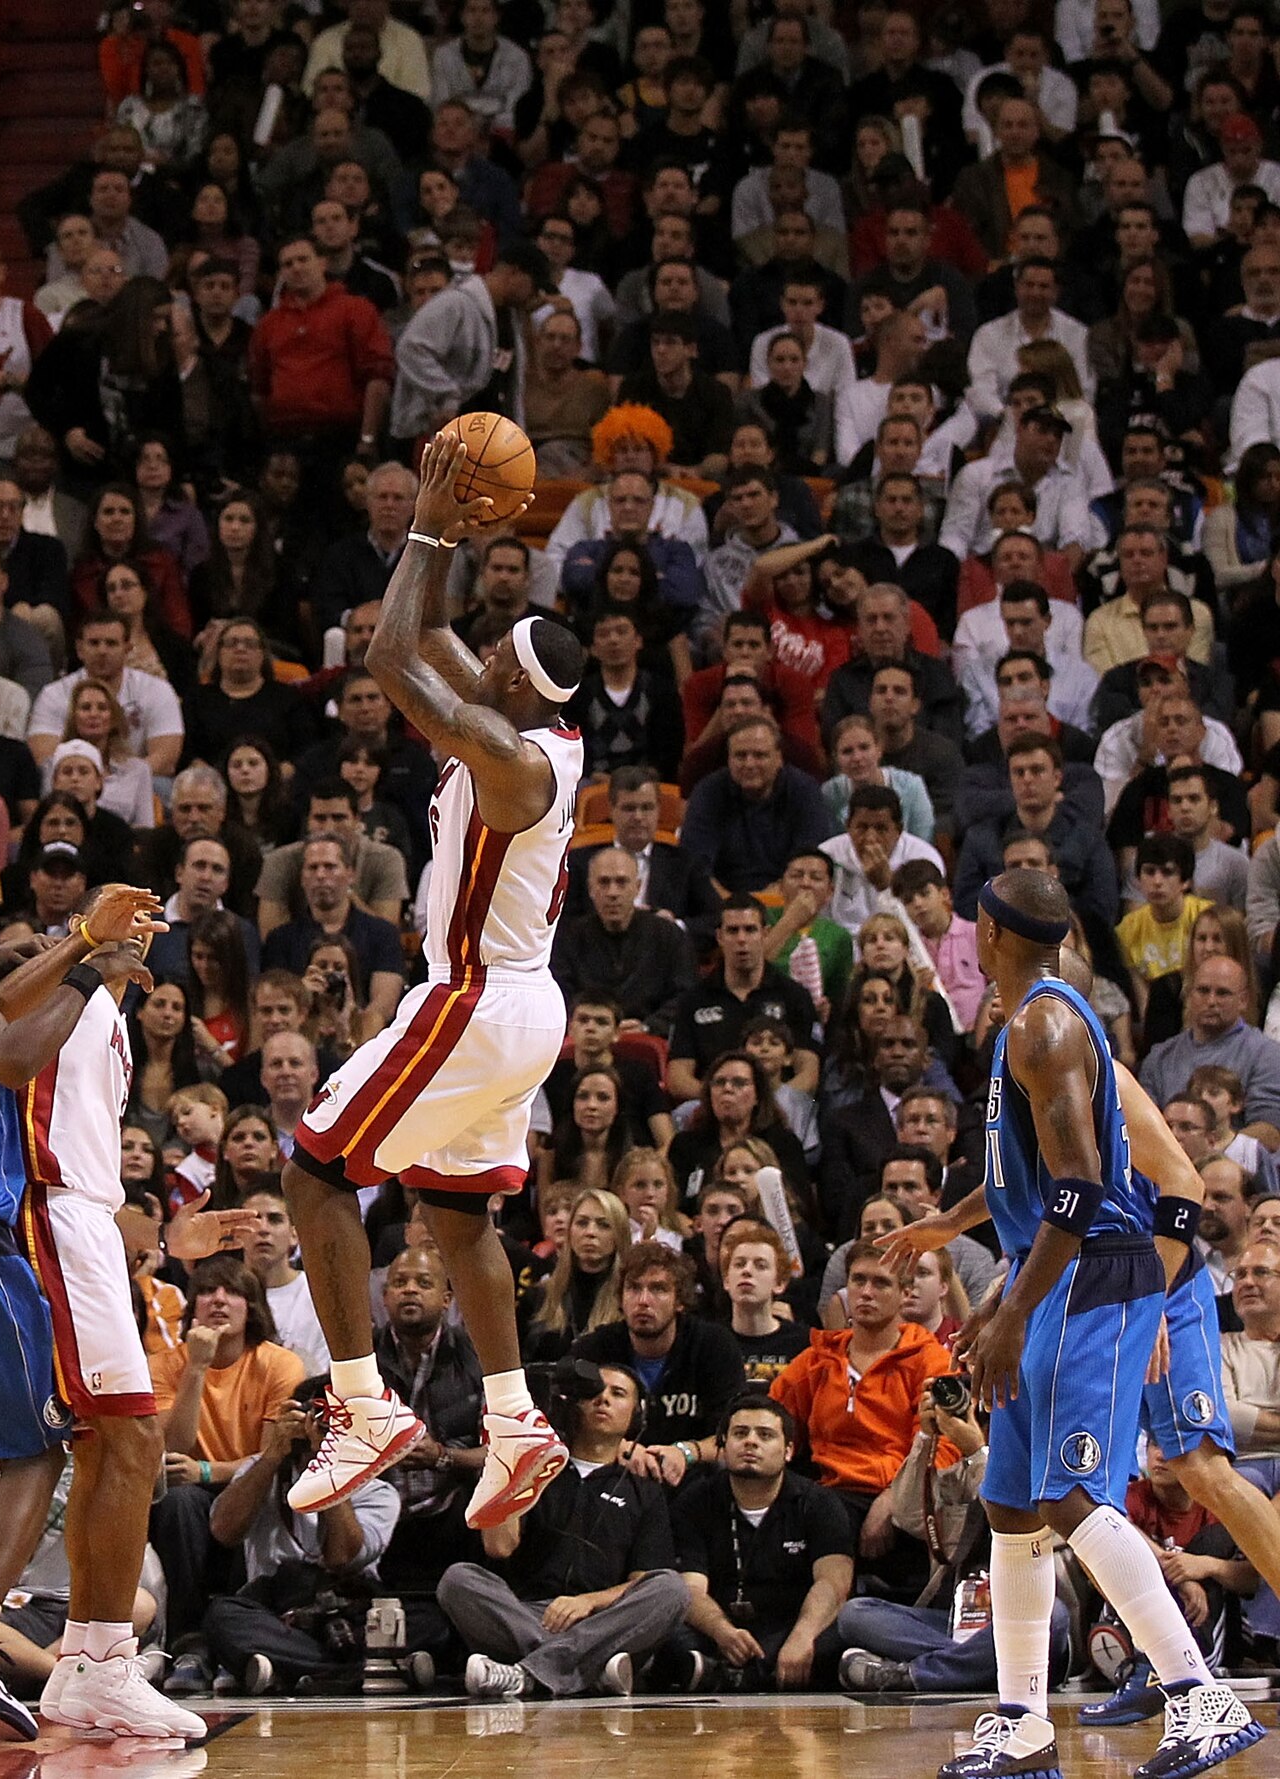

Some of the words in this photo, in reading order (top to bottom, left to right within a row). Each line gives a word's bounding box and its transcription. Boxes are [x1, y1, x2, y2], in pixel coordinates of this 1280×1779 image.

[1053, 1189, 1080, 1218] 31
[1174, 1208, 1189, 1229] 2
[926, 1514, 940, 1550] Canon
